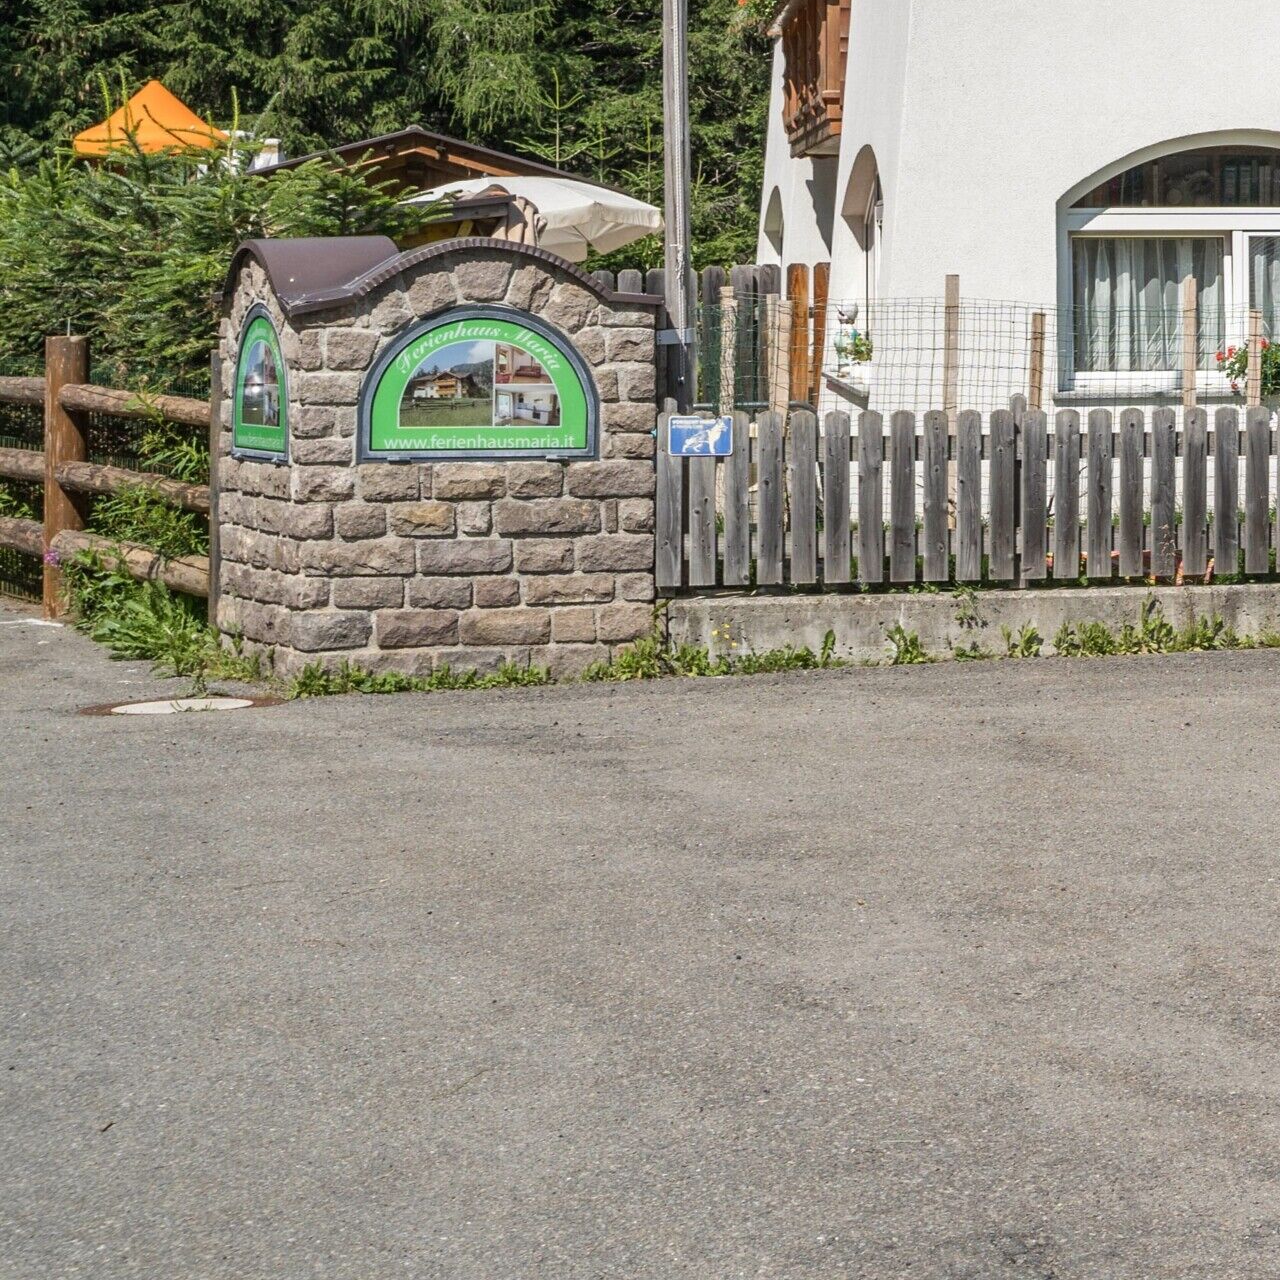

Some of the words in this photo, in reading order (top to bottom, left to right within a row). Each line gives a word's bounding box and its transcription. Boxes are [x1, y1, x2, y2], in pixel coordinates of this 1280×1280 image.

[395, 322, 501, 374] Ferienhaus
[505, 328, 561, 371] Maria
[384, 434, 575, 449] www.ferienhausmaria.it
